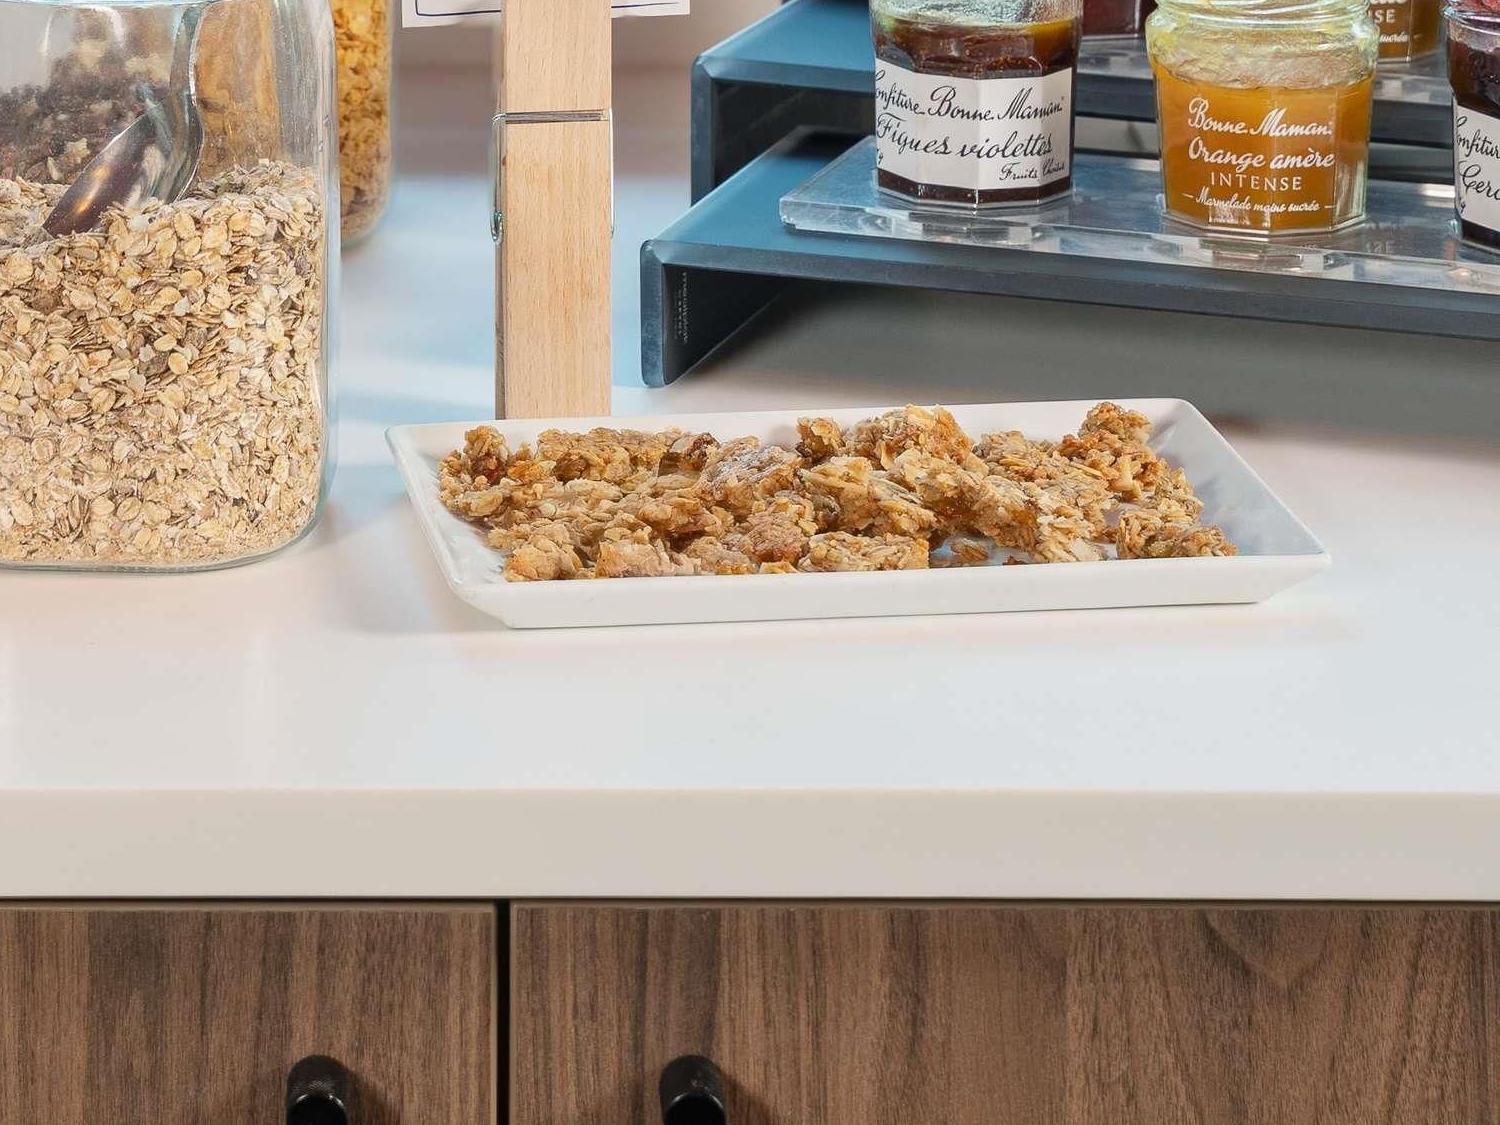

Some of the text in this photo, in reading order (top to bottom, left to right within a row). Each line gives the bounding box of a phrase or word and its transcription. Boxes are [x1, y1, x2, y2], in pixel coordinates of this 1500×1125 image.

[927, 85, 994, 121] Bonne
[997, 87, 1061, 120] Maman
[1188, 97, 1332, 137] Bonne Maman
[877, 112, 1053, 159] Figues violettes
[1188, 136, 1336, 173] Orange amère
[1196, 186, 1251, 210] Marmelade
[1288, 200, 1320, 212] sucrée
[1211, 172, 1302, 191] INTENSE
